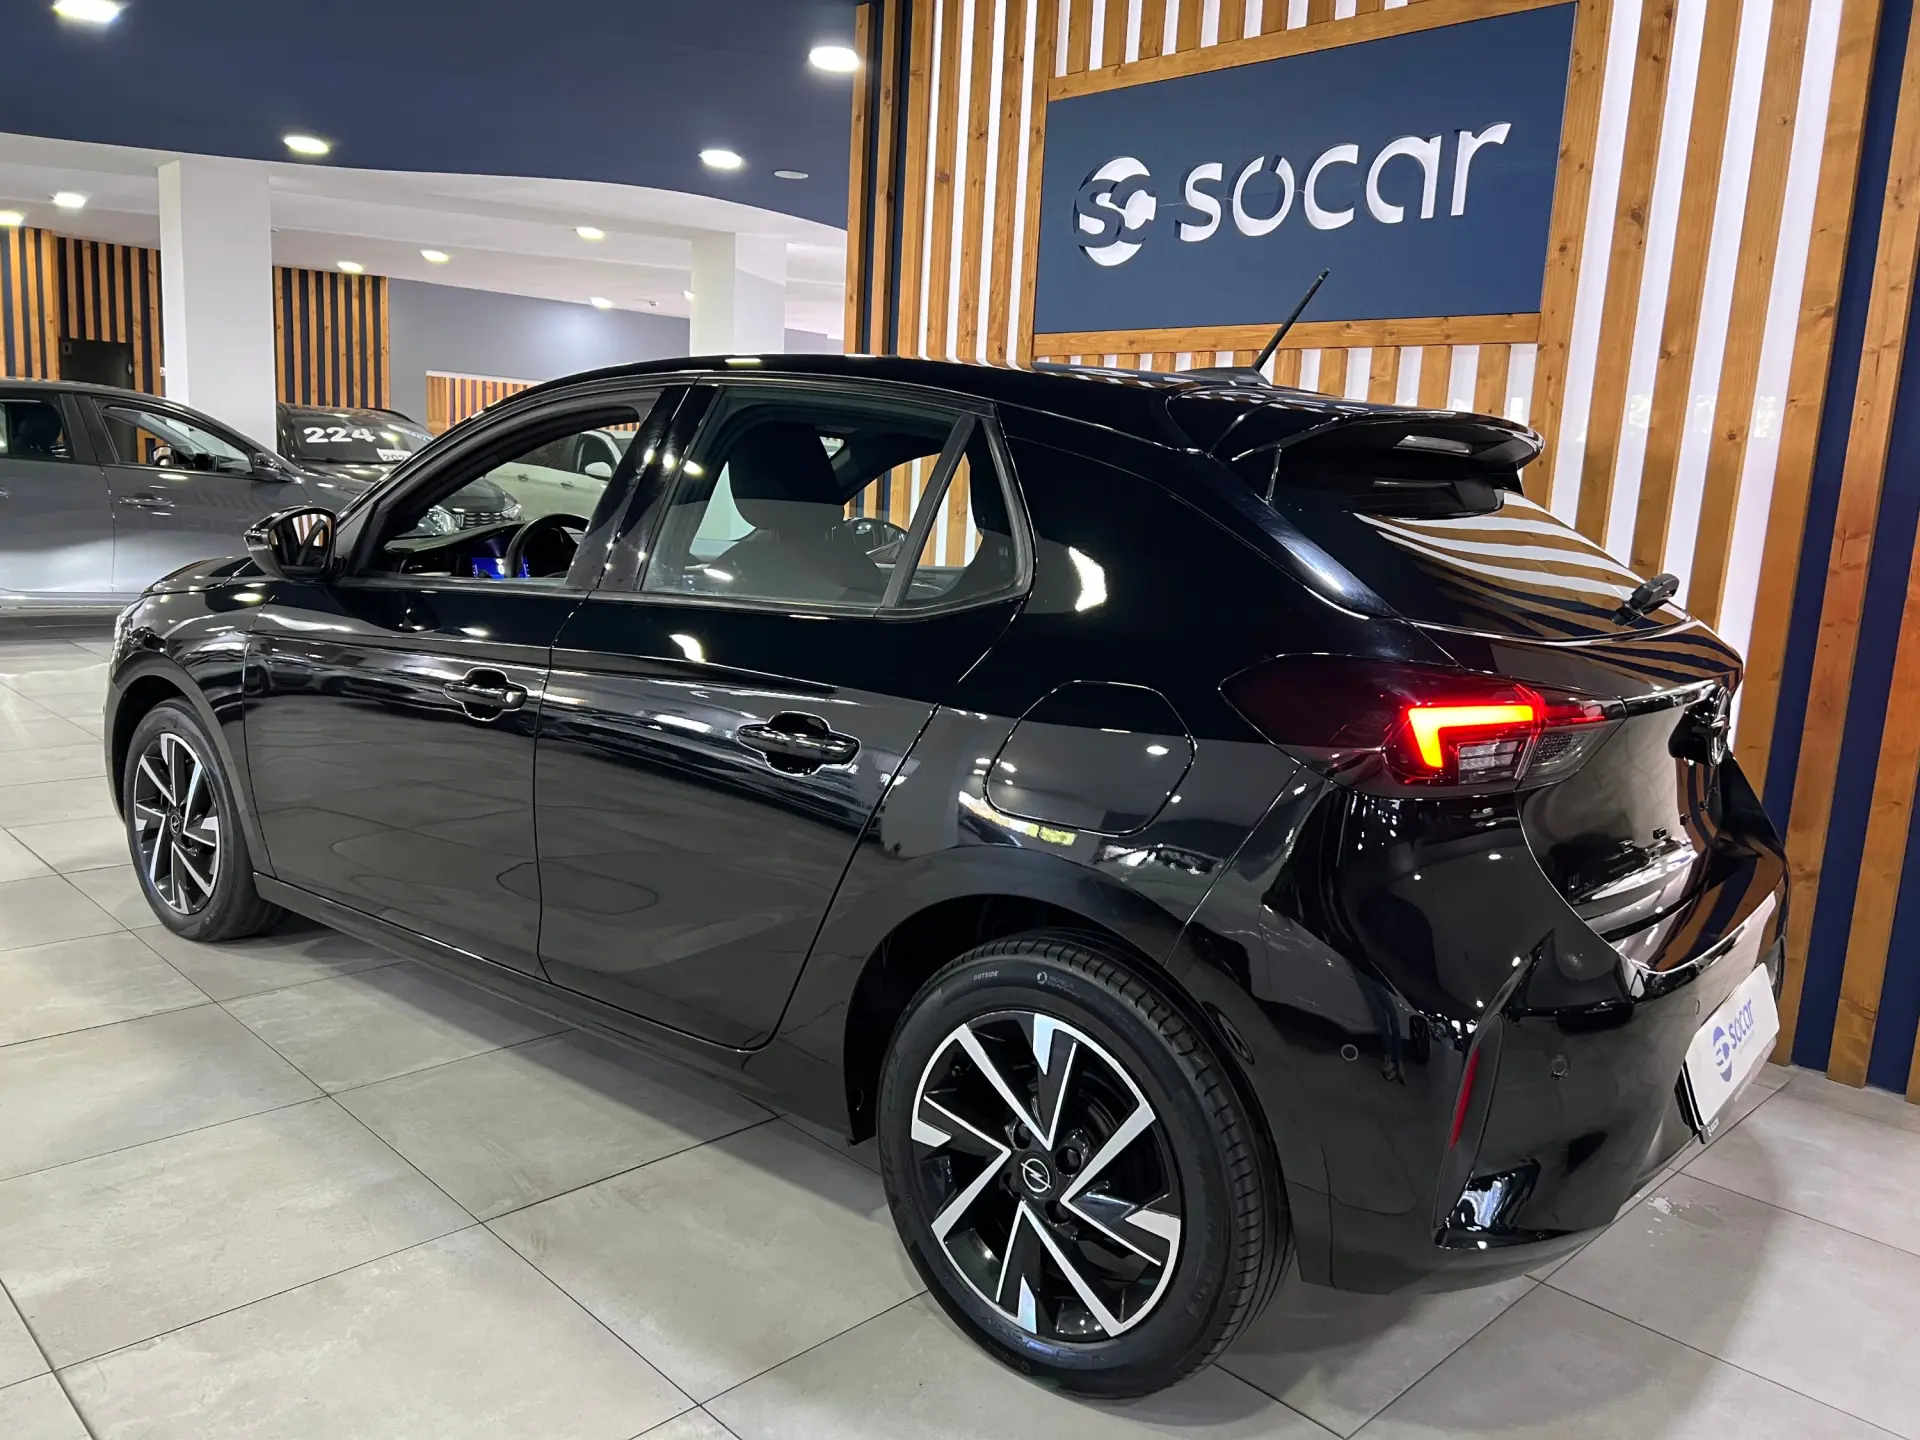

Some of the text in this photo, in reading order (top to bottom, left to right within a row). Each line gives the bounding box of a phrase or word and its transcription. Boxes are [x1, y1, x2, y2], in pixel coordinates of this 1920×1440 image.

[1174, 121, 1512, 241] socar
[303, 426, 376, 443] 224
[973, 970, 999, 981] OUTSIDE
[1728, 998, 1754, 1050] socar
